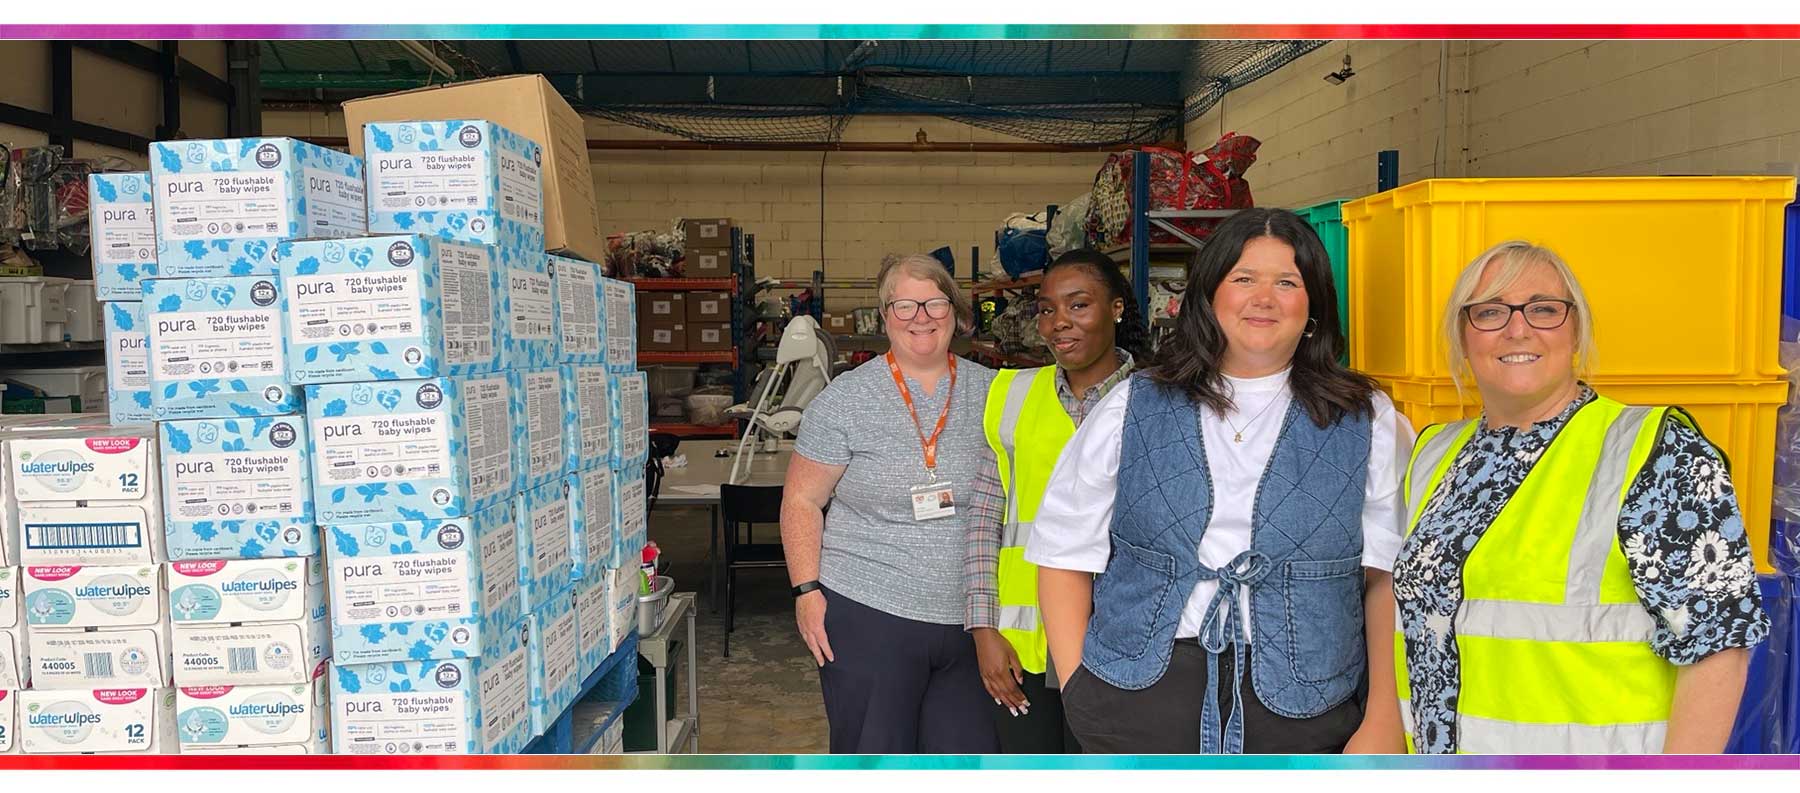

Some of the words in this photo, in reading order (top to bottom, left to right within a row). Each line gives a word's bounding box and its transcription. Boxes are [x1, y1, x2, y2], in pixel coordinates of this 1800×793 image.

[438, 154, 476, 162] flushable
[380, 158, 413, 172] pura
[426, 162, 446, 170] baby
[448, 161, 472, 170] wipes
[214, 178, 230, 186] 720
[232, 176, 274, 186] flushable
[310, 177, 331, 193] pura
[168, 180, 204, 197] pura
[220, 185, 240, 195] baby
[244, 184, 270, 194] wipes
[104, 210, 136, 224] pura
[344, 278, 362, 286] 720
[364, 275, 408, 285] flushable
[296, 282, 335, 299] pura
[351, 286, 372, 295] baby
[376, 284, 404, 294] wipes
[206, 316, 223, 324] 720
[226, 314, 270, 323] flushable
[159, 320, 196, 336] pura
[213, 324, 234, 333] baby
[238, 323, 266, 332] wipes
[372, 420, 389, 428] 720
[392, 418, 436, 427] flushable
[324, 424, 362, 440] pura
[378, 428, 400, 437] baby
[404, 426, 432, 436] wipes
[224, 458, 242, 466] 720
[244, 456, 288, 466] flushable
[176, 461, 214, 478] pura
[231, 466, 252, 474] baby
[256, 464, 284, 473] wipes
[118, 474, 138, 486] 12
[392, 561, 410, 569] 720
[412, 558, 456, 568] flushable
[344, 564, 382, 582] pura
[400, 568, 420, 577] baby
[424, 566, 452, 576] wipes
[42, 662, 76, 670] 440005
[184, 657, 218, 666] 440005
[392, 698, 408, 706] 720
[411, 696, 454, 706] flushable
[346, 700, 382, 716] pura
[398, 705, 419, 714] baby
[422, 704, 450, 713] wipes
[0, 725, 6, 738] 2
[125, 724, 144, 738] 12
